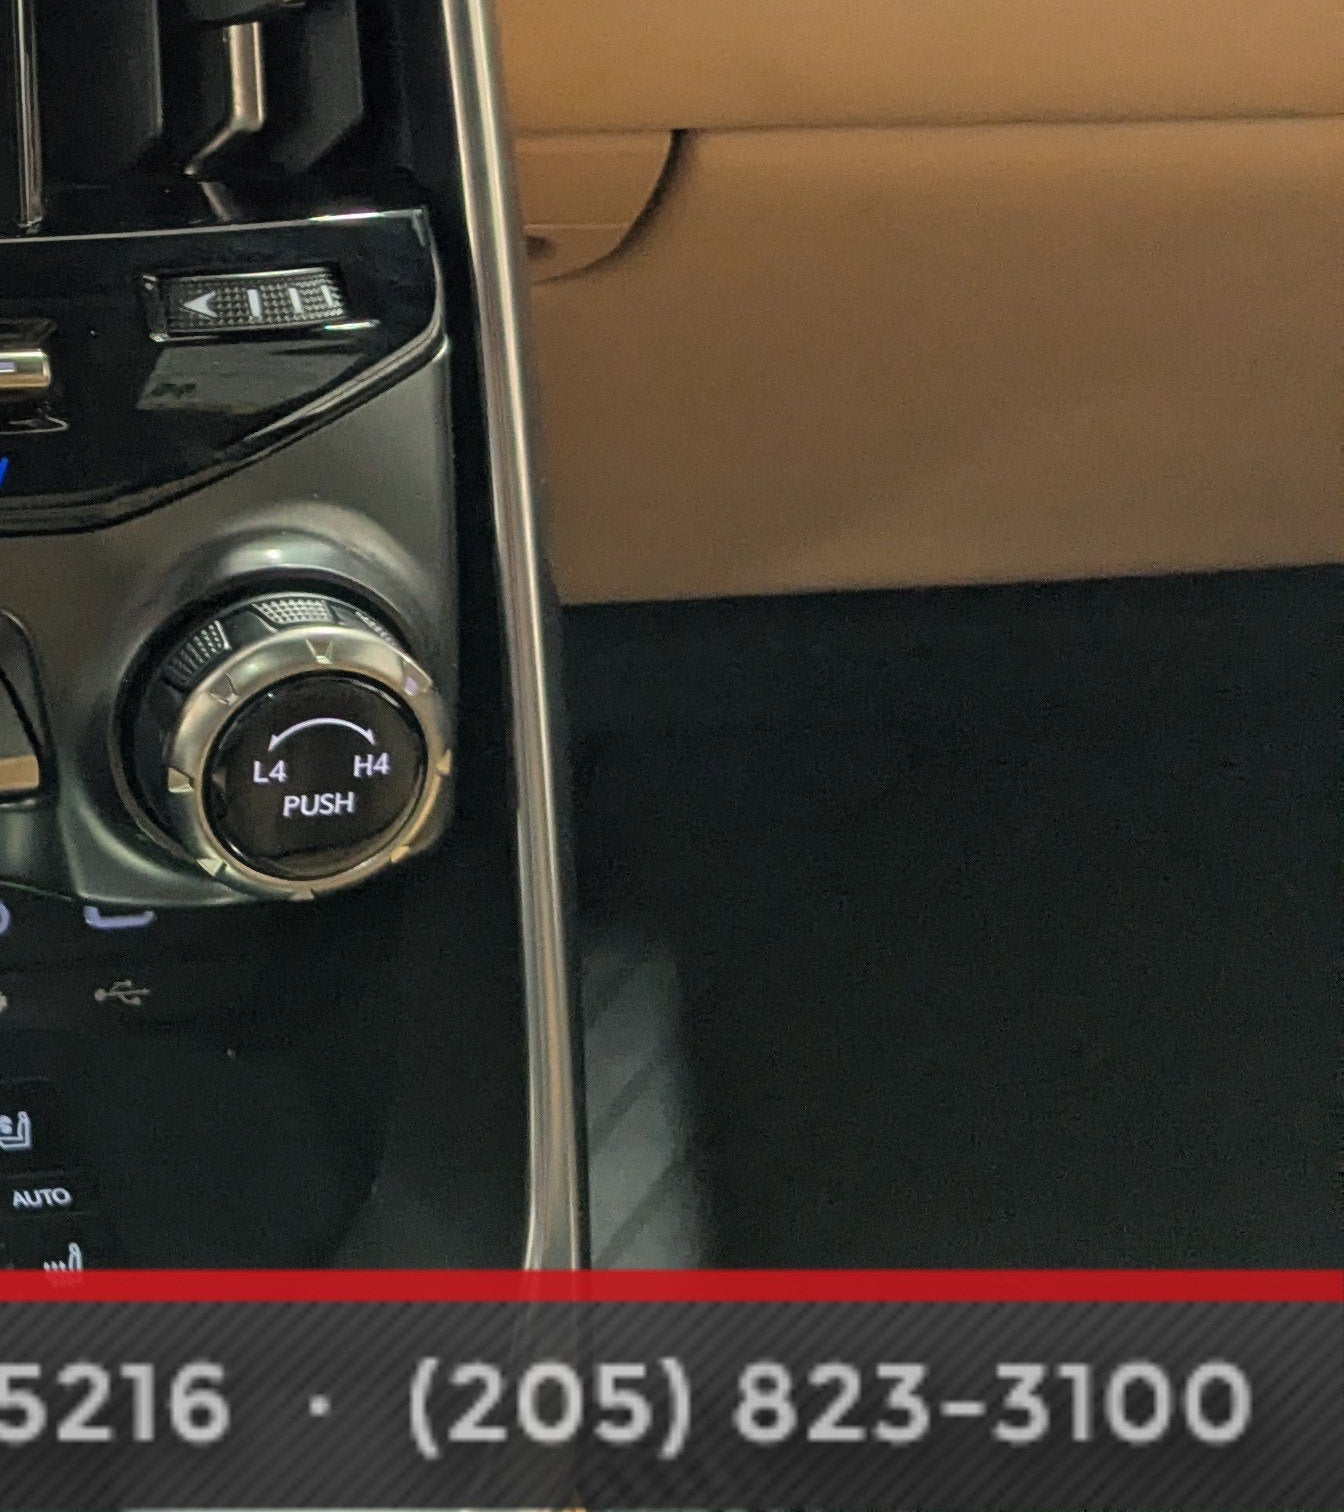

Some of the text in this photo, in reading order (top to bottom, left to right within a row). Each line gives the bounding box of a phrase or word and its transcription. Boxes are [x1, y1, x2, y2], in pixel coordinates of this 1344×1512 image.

[253, 760, 287, 785] L4
[353, 752, 391, 779] H4
[282, 792, 355, 818] PUSH
[13, 1187, 72, 1209] AUTO
